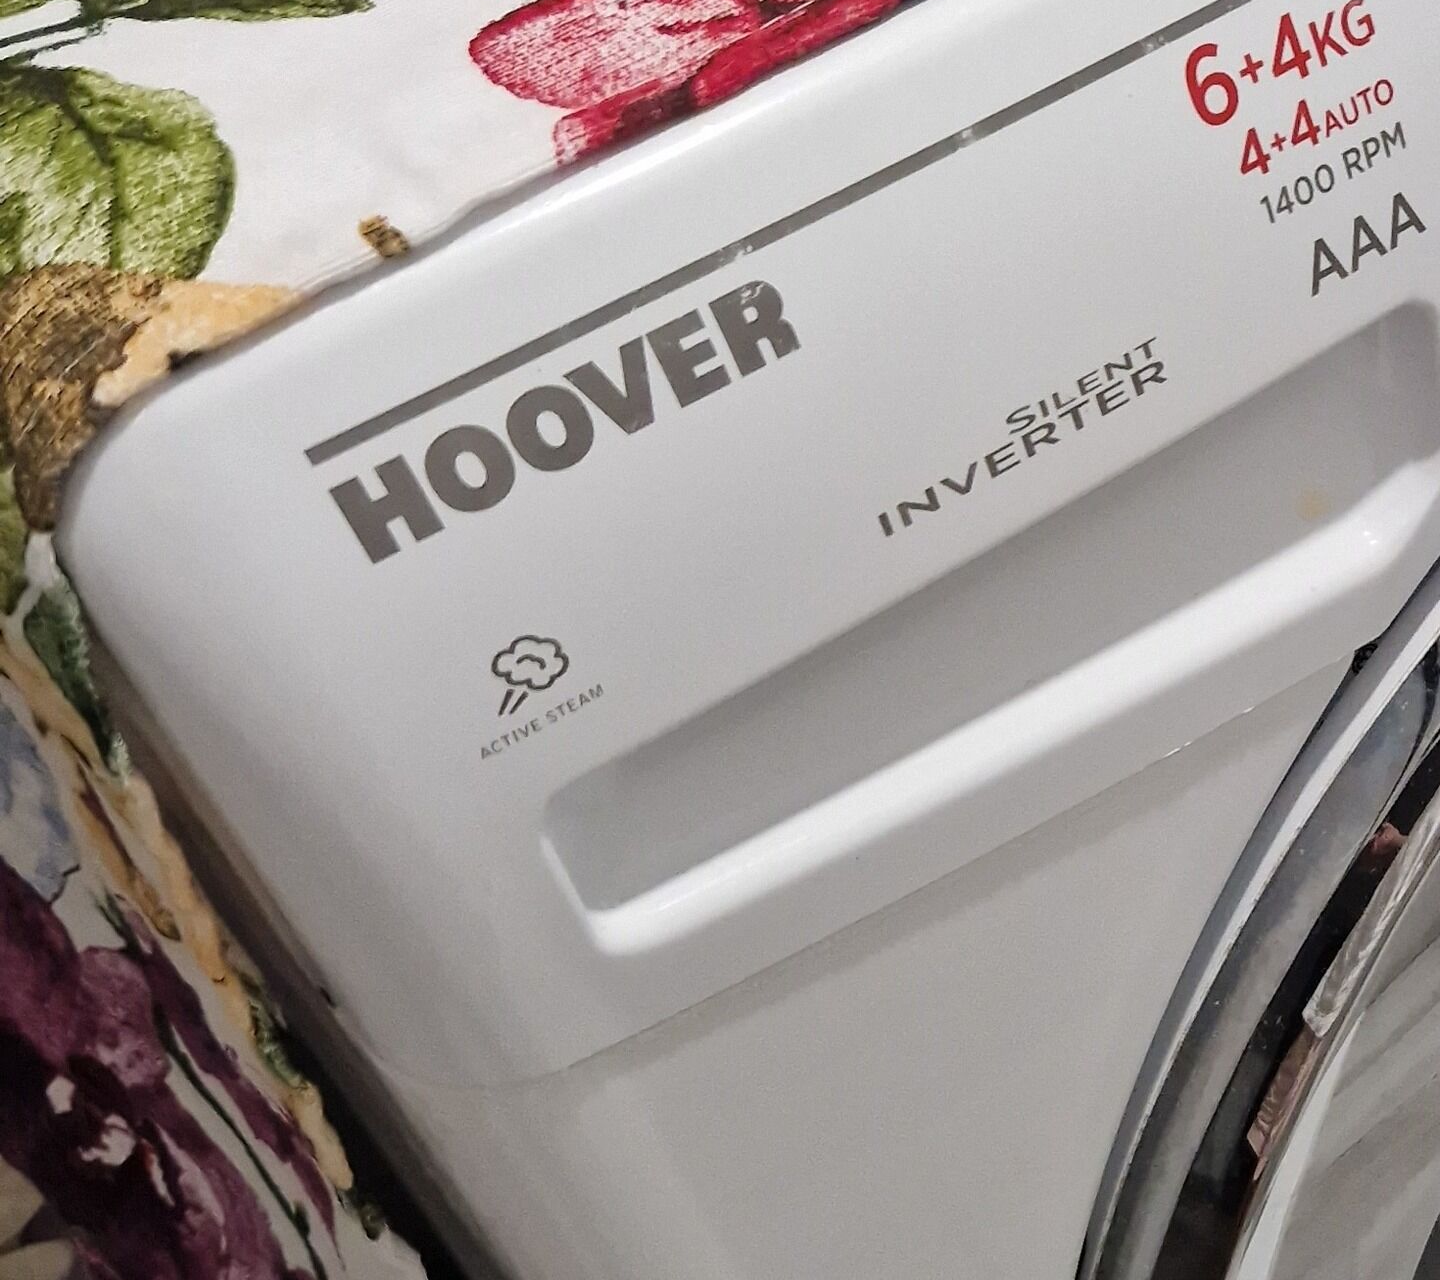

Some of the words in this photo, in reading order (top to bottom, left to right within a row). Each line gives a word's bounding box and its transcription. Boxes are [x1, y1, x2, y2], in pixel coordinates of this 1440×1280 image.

[1259, 163, 1336, 224] 1400
[1341, 121, 1407, 180] RPM
[1311, 191, 1427, 298] AAA
[329, 279, 802, 565] HOOVER
[1005, 336, 1157, 435] SILENT
[878, 361, 1168, 537] INVERTER
[480, 718, 542, 760] ACTIVE
[545, 684, 604, 723] STEAM
